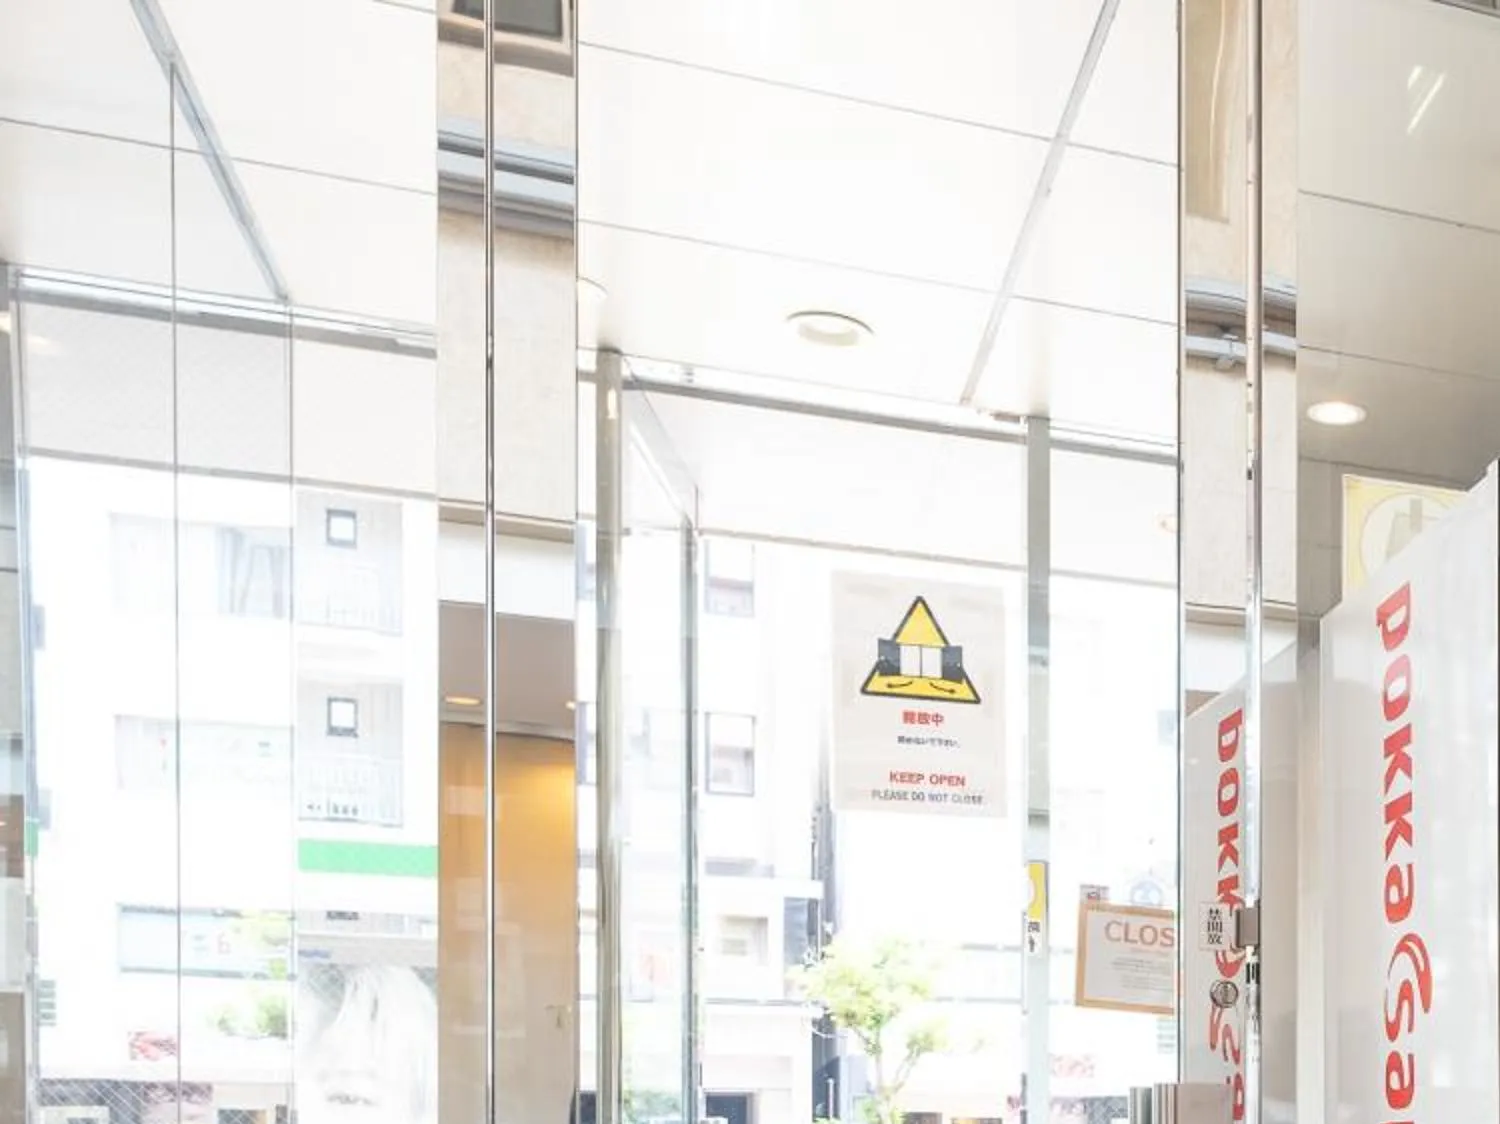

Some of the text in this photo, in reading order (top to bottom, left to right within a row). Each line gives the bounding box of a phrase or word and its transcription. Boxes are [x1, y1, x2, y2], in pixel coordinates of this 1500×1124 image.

[889, 771, 966, 787] KEEP OPEN
[871, 789, 909, 801] PLEASE
[911, 790, 925, 801] DO
[927, 792, 948, 803] NOT
